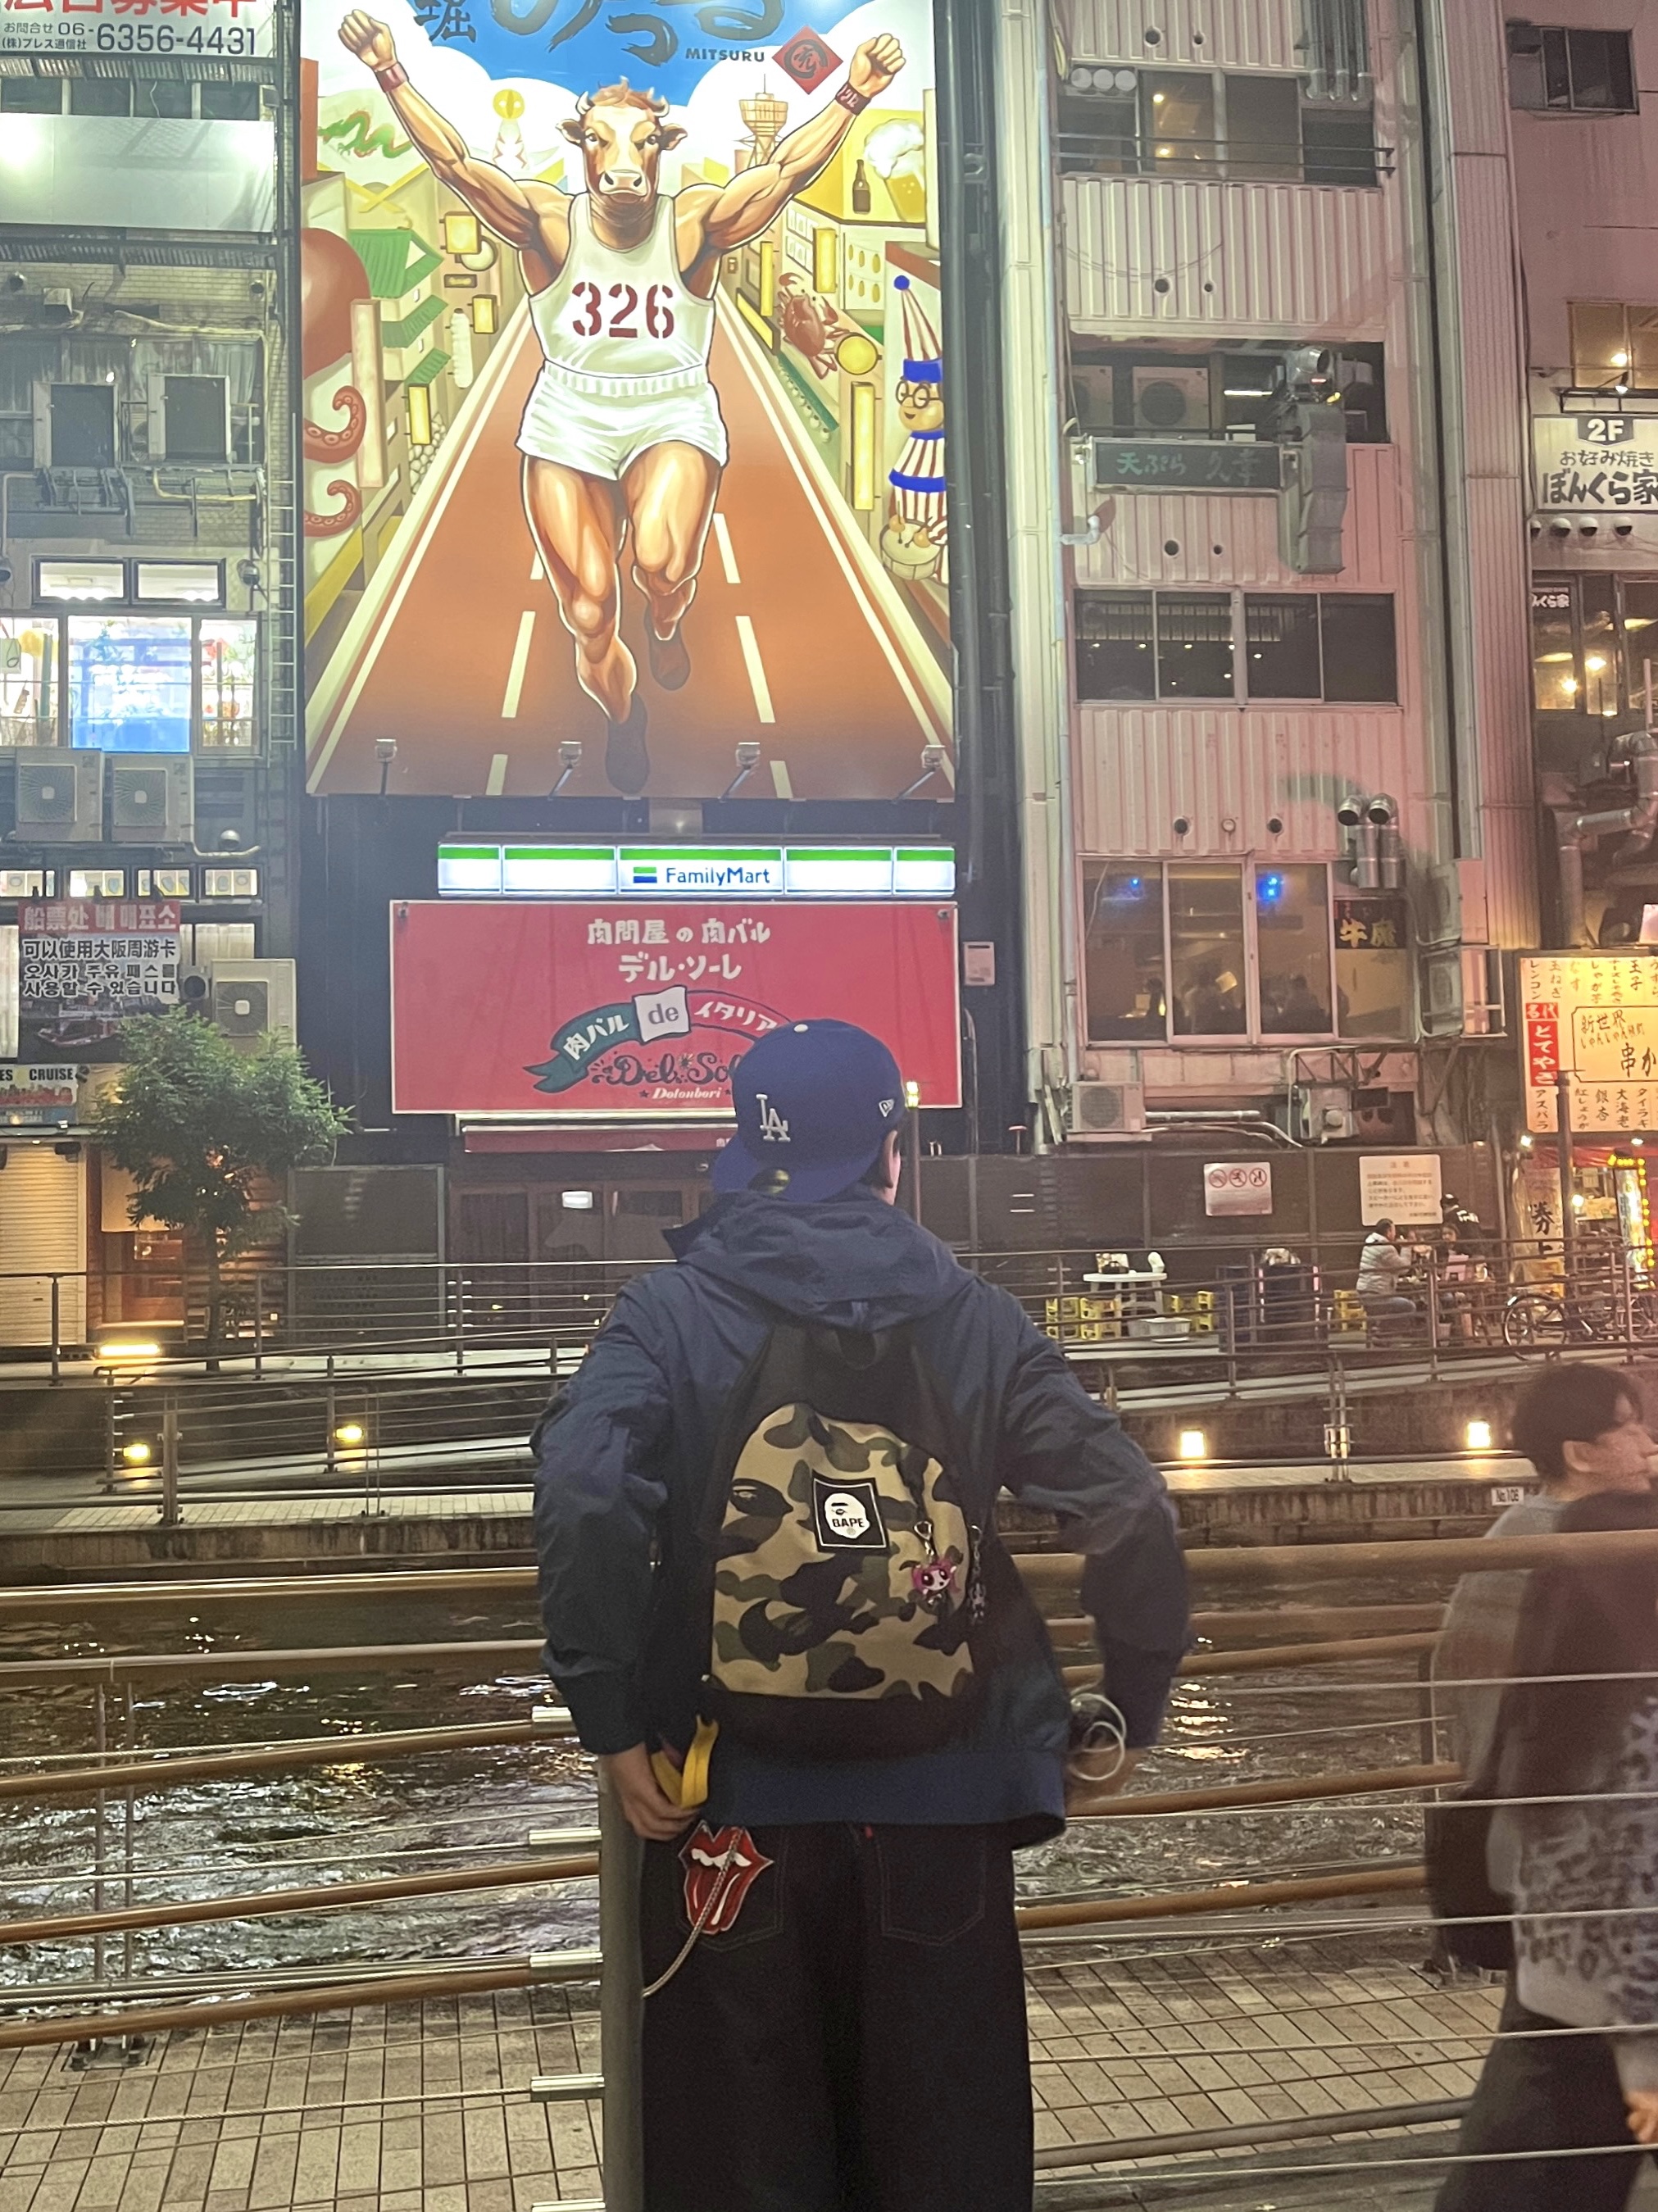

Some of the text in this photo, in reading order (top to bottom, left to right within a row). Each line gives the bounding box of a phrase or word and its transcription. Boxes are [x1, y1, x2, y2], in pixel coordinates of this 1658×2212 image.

[4, 22, 255, 55] お問合せ 06-6356-4431
[685, 47, 765, 62] MITSURU
[572, 281, 675, 339] 326
[1587, 418, 1625, 442] 2F
[1115, 451, 1187, 475] 天ぷら
[1560, 450, 1655, 468] お好み焼き
[1542, 468, 1658, 506] ぼんくら家
[665, 867, 770, 887] FamilyMart
[24, 906, 89, 931] 船票处
[587, 918, 771, 945] 肉問屋 の 肉バル
[24, 939, 176, 960] 可以使用大阪周游卡
[25, 964, 78, 979] 오사카
[87, 965, 120, 979] 주유
[619, 952, 742, 983] デル・ソーレ
[1530, 960, 1542, 1000] レンコン
[25, 981, 176, 997] 사용할 수 있습니다
[563, 1014, 629, 1061] 肉バル
[647, 1003, 679, 1024] de
[1581, 1009, 1626, 1034] 新世界
[30, 1068, 74, 1081] CRUISE
[756, 1093, 791, 1142] LA
[1535, 1089, 1548, 1130] アスパラ
[1615, 1088, 1629, 1129] 大海老
[832, 1518, 865, 1528] BAPE
